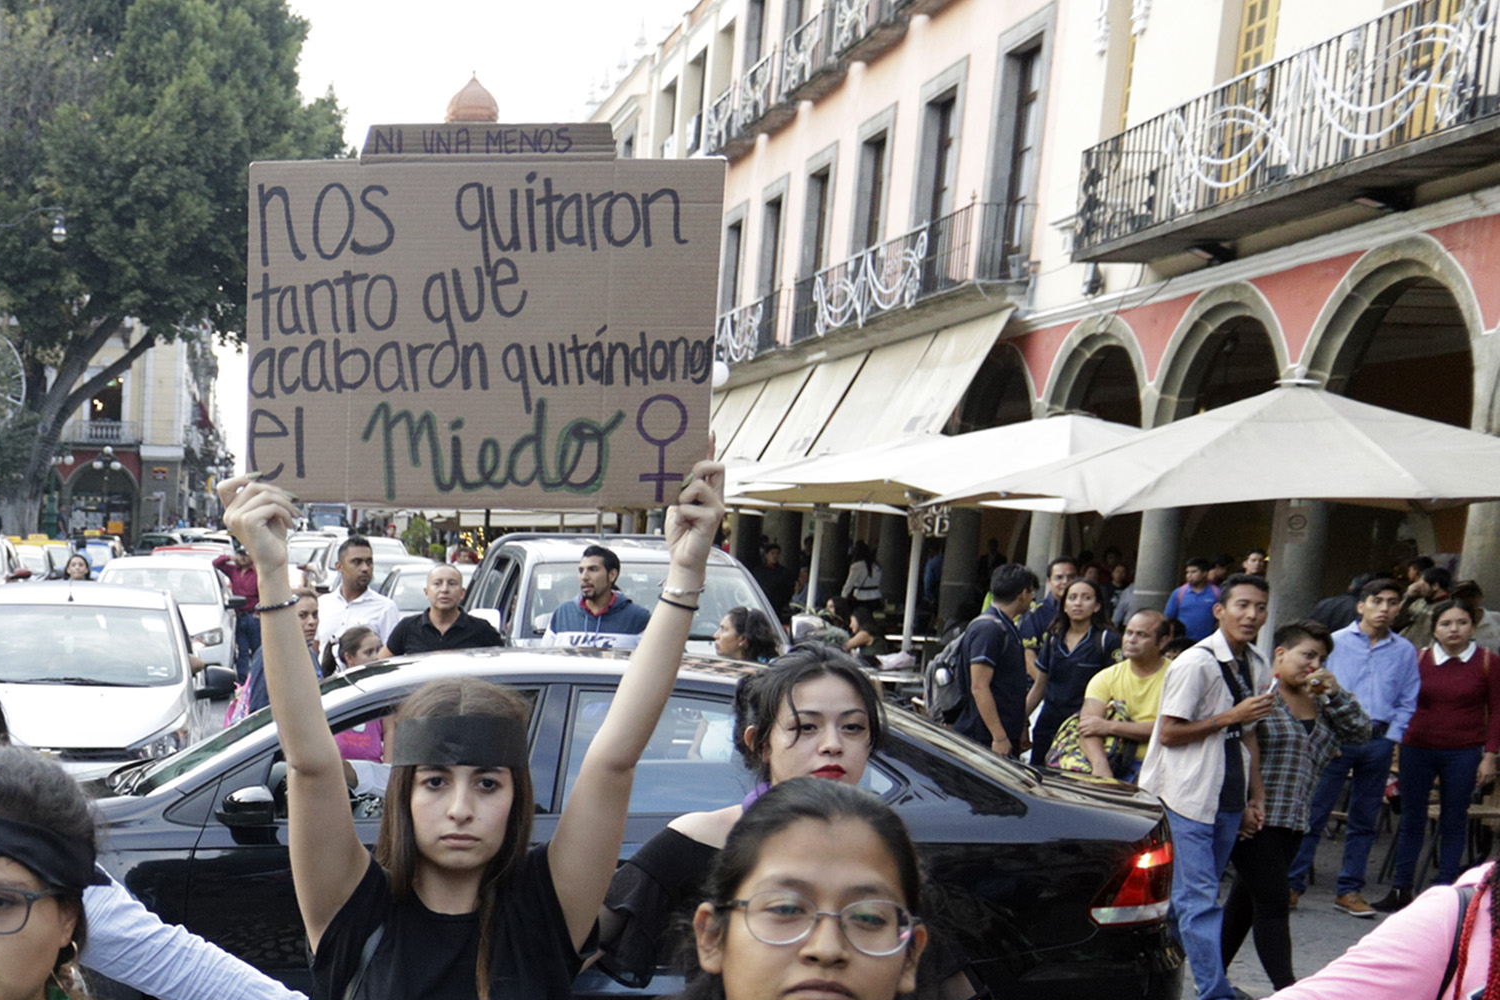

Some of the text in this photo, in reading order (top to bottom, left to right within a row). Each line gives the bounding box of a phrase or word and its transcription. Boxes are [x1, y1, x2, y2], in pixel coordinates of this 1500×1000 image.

[375, 127, 574, 155] NI UNA MENOS
[257, 171, 689, 277] nos quitaron
[252, 257, 528, 349] tanto que
[248, 405, 306, 481] el
